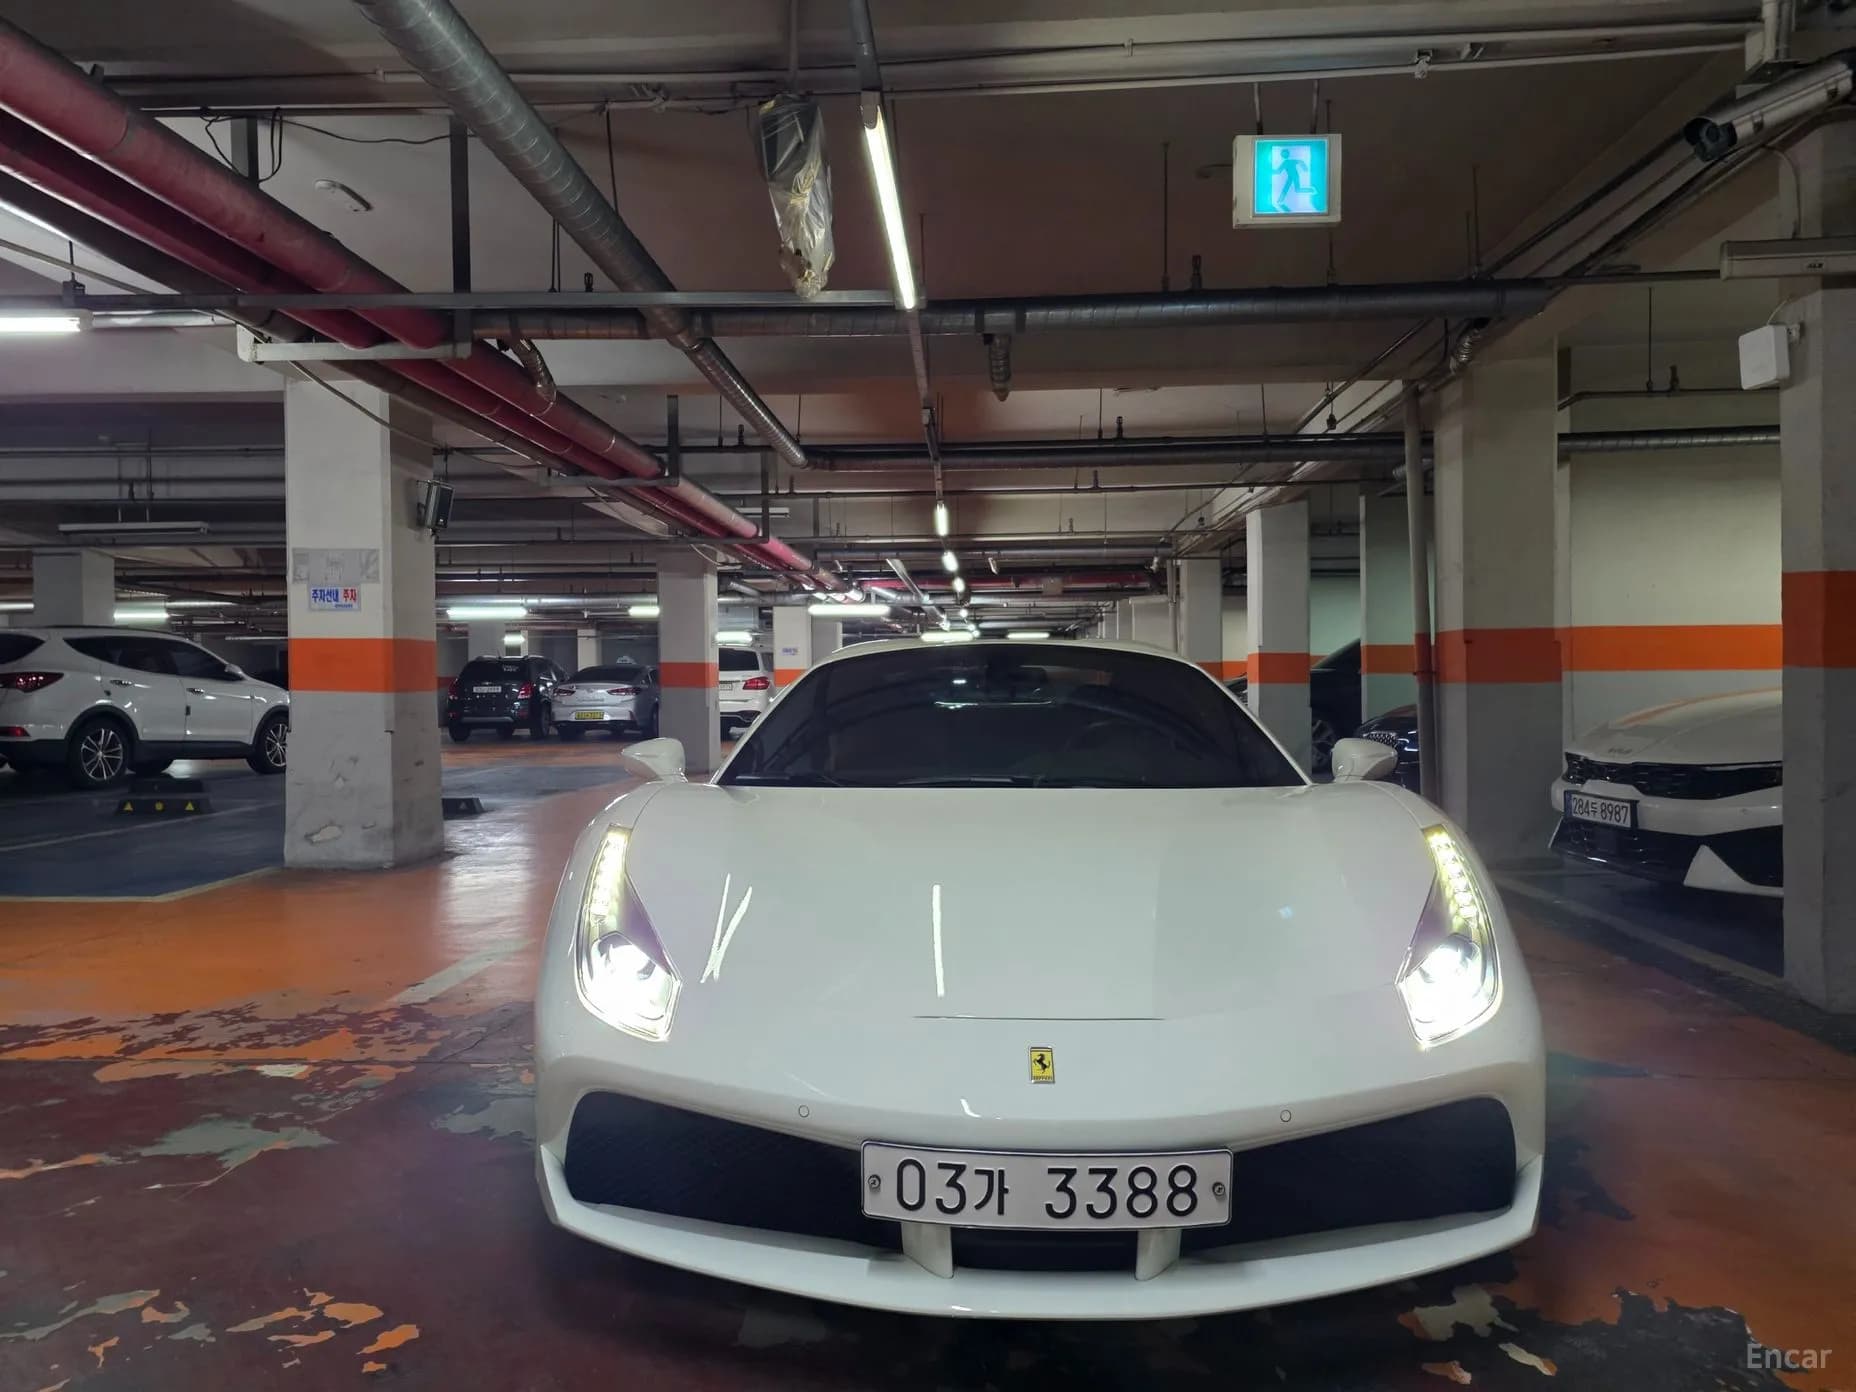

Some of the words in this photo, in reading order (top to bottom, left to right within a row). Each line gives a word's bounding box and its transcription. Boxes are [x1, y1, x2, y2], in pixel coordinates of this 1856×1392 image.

[1600, 801, 1629, 825] 8987
[896, 1158, 1010, 1216] 03가
[1045, 1163, 1199, 1219] 3388
